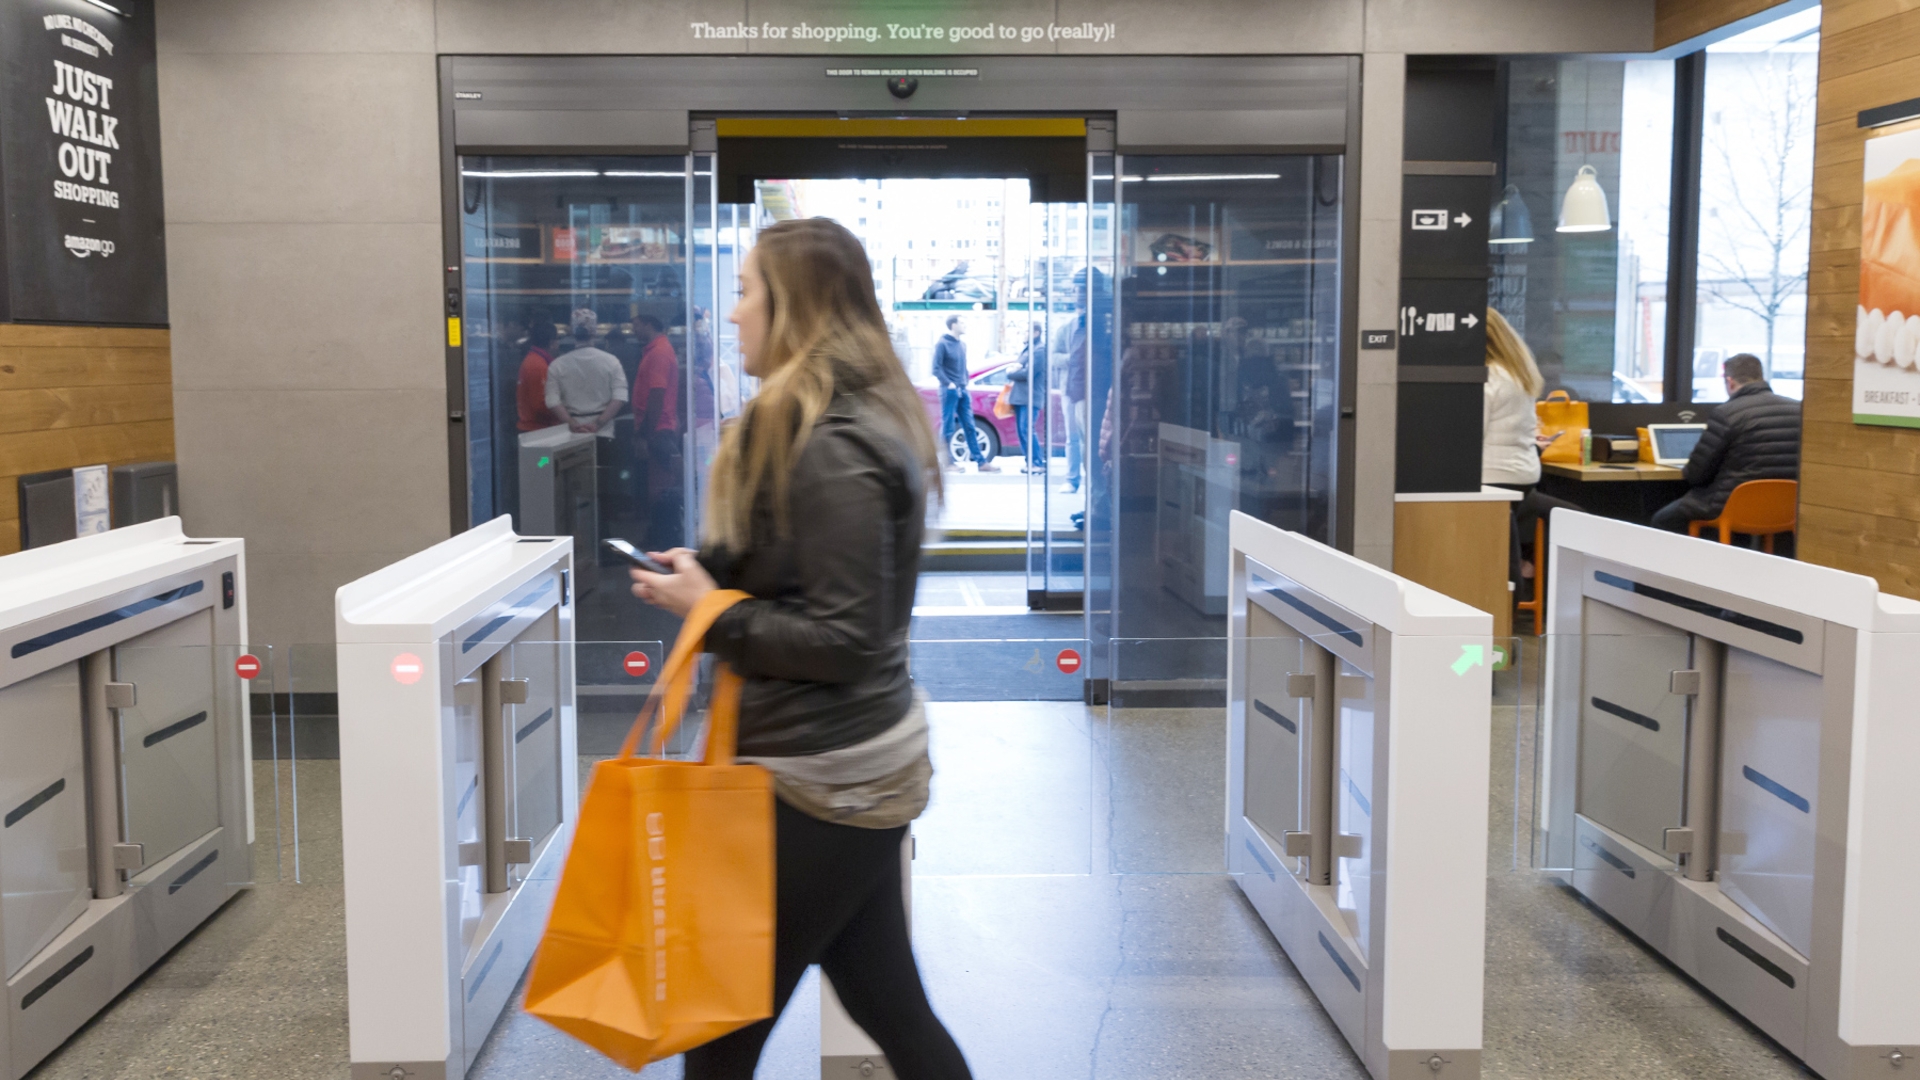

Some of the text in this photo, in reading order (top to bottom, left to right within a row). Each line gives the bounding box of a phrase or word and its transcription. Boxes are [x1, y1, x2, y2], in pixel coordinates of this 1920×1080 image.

[690, 22, 1115, 42] Thanks for shopping. You're good to go (really)!
[53, 59, 113, 110] JUST
[46, 97, 119, 149] WALK
[58, 142, 111, 184] OUT
[54, 180, 119, 209] SHOPPING
[1368, 334, 1387, 344] EXIT
[1864, 390, 1909, 405] BREAKFAST
